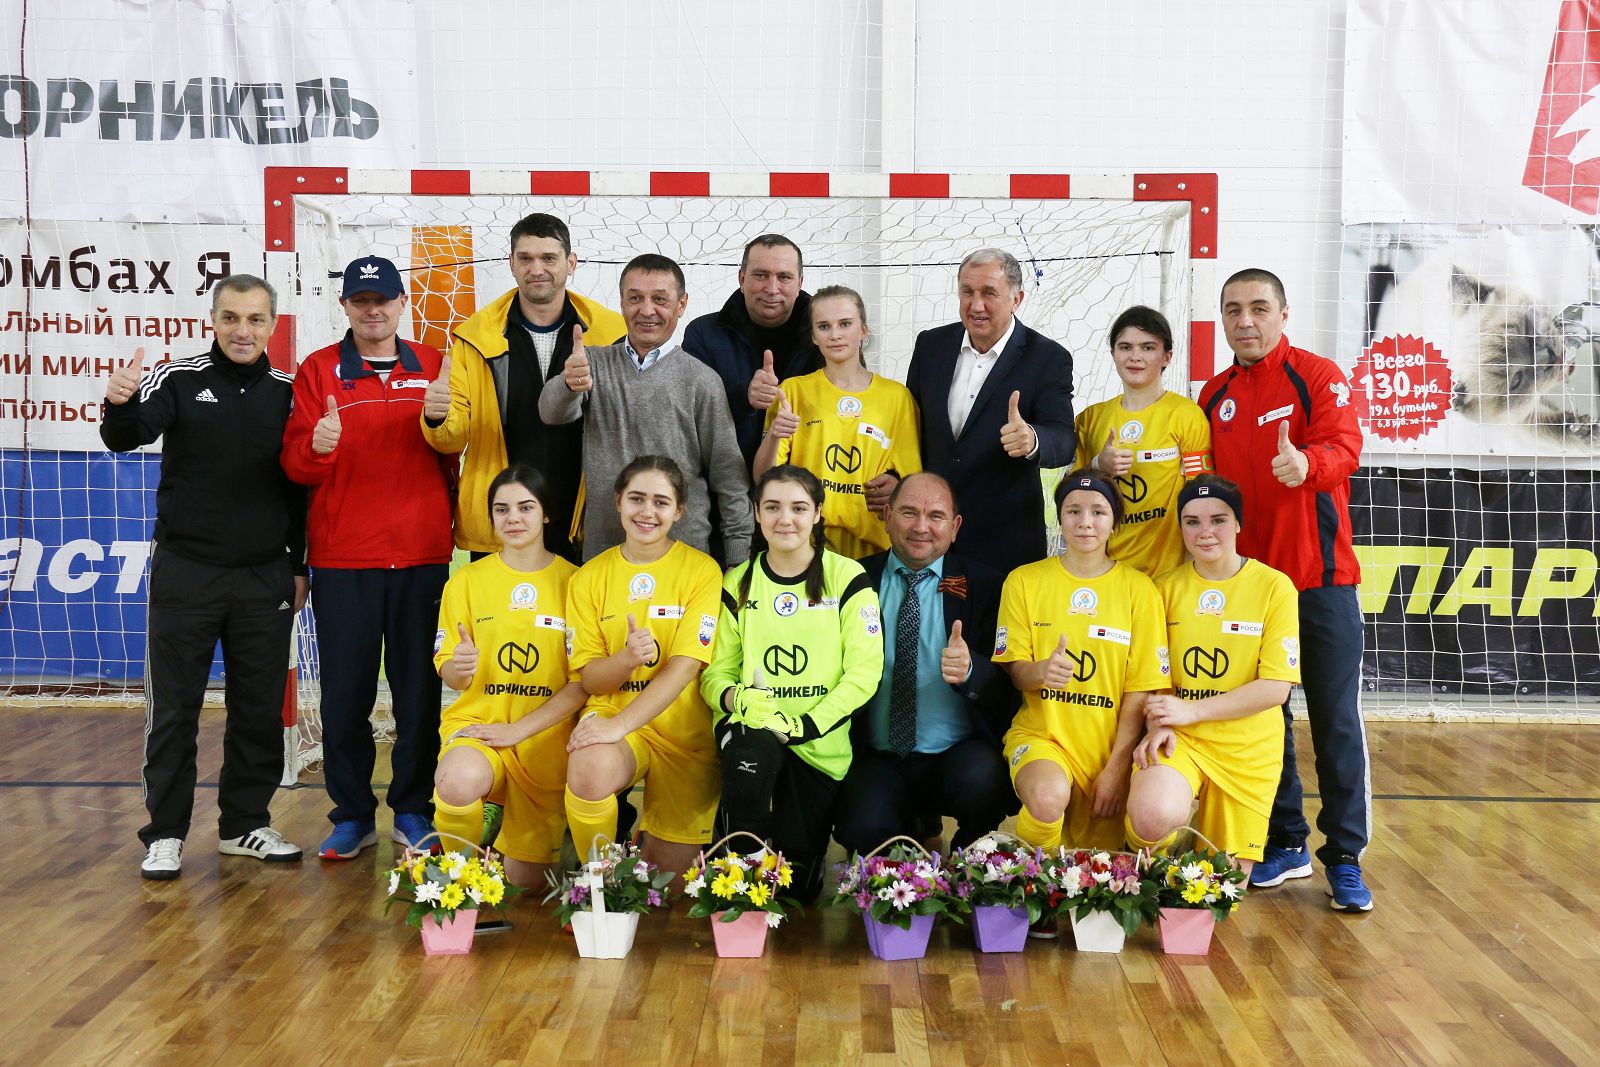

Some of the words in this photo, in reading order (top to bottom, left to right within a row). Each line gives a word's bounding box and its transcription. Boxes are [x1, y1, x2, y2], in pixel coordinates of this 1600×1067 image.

[0, 75, 380, 145] ОРНИКЕЛЬ
[196, 251, 231, 296] Я
[0, 307, 114, 337] льный
[1372, 353, 1424, 370] Всего
[1359, 371, 1410, 400] 130
[1413, 379, 1442, 398] руб.
[1370, 404, 1391, 417] 19л
[1392, 402, 1437, 416] бутыль
[820, 479, 864, 496] РНИКЕ
[1352, 545, 1600, 618] ПАР
[1040, 688, 1114, 709] ОРНИКЕЛЬ
